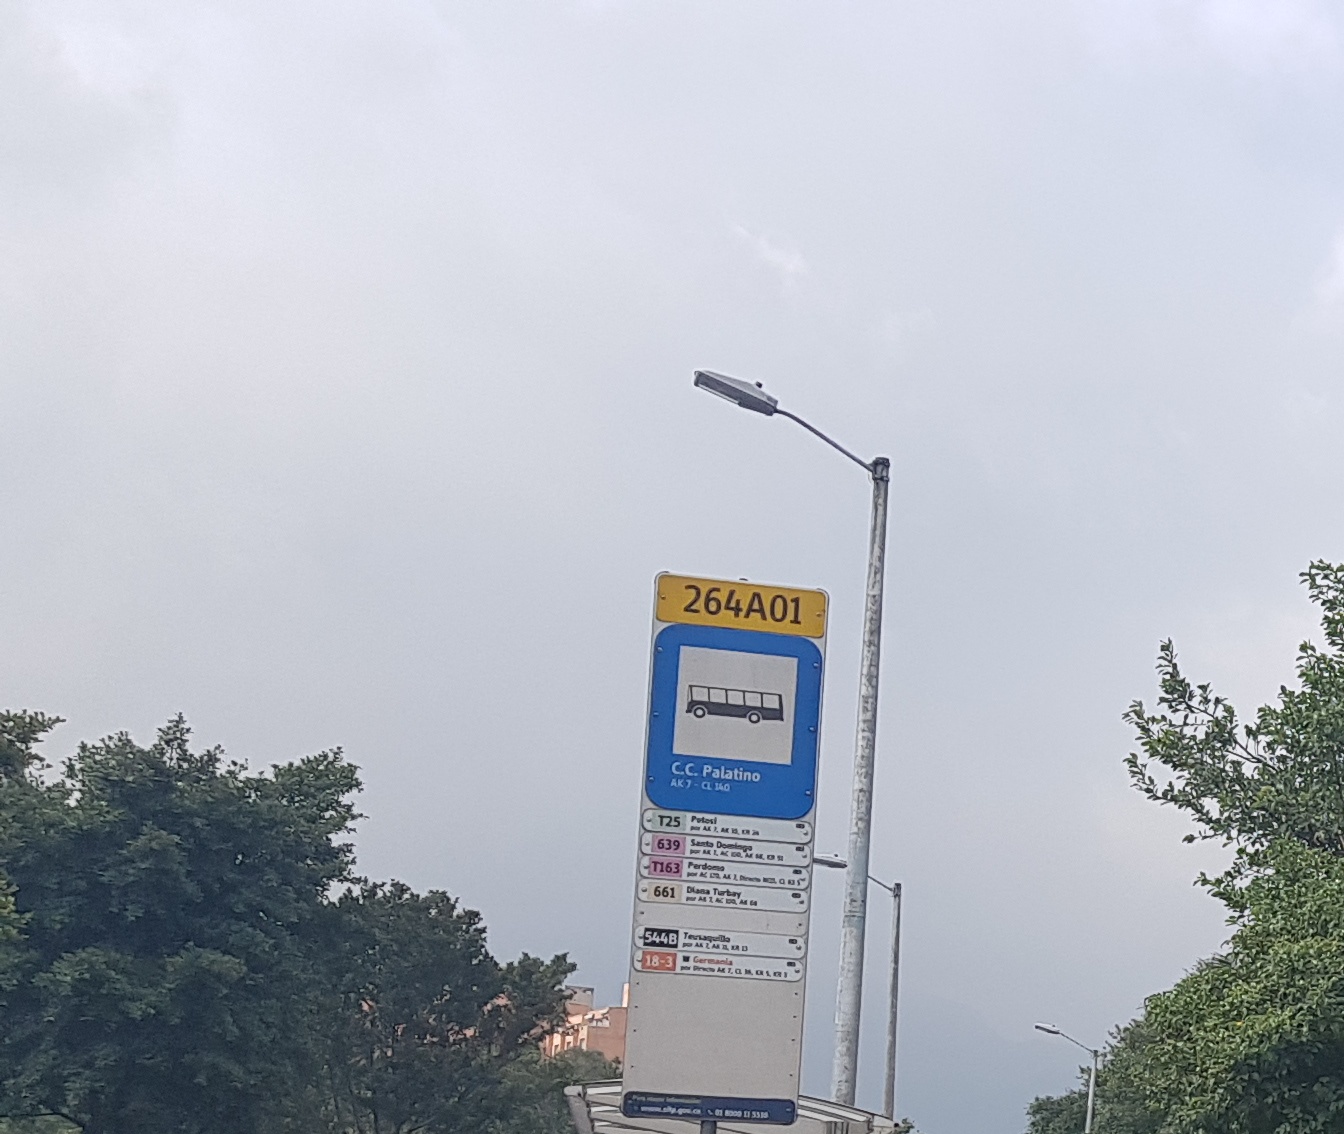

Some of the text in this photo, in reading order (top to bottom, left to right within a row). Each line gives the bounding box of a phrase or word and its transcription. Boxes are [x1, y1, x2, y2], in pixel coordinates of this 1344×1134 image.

[683, 584, 802, 626] 264A01
[671, 761, 761, 782] C.C. Palatino
[670, 778, 684, 788] AK
[686, 780, 692, 789] 7
[701, 781, 713, 791] CL
[714, 783, 731, 792] 140
[657, 814, 681, 828] T25
[656, 838, 681, 851] 639
[651, 860, 681, 874] T163
[653, 885, 676, 899] 661
[712, 887, 742, 900] Turbay
[644, 930, 678, 945] 544B
[645, 954, 673, 968] 18-3
